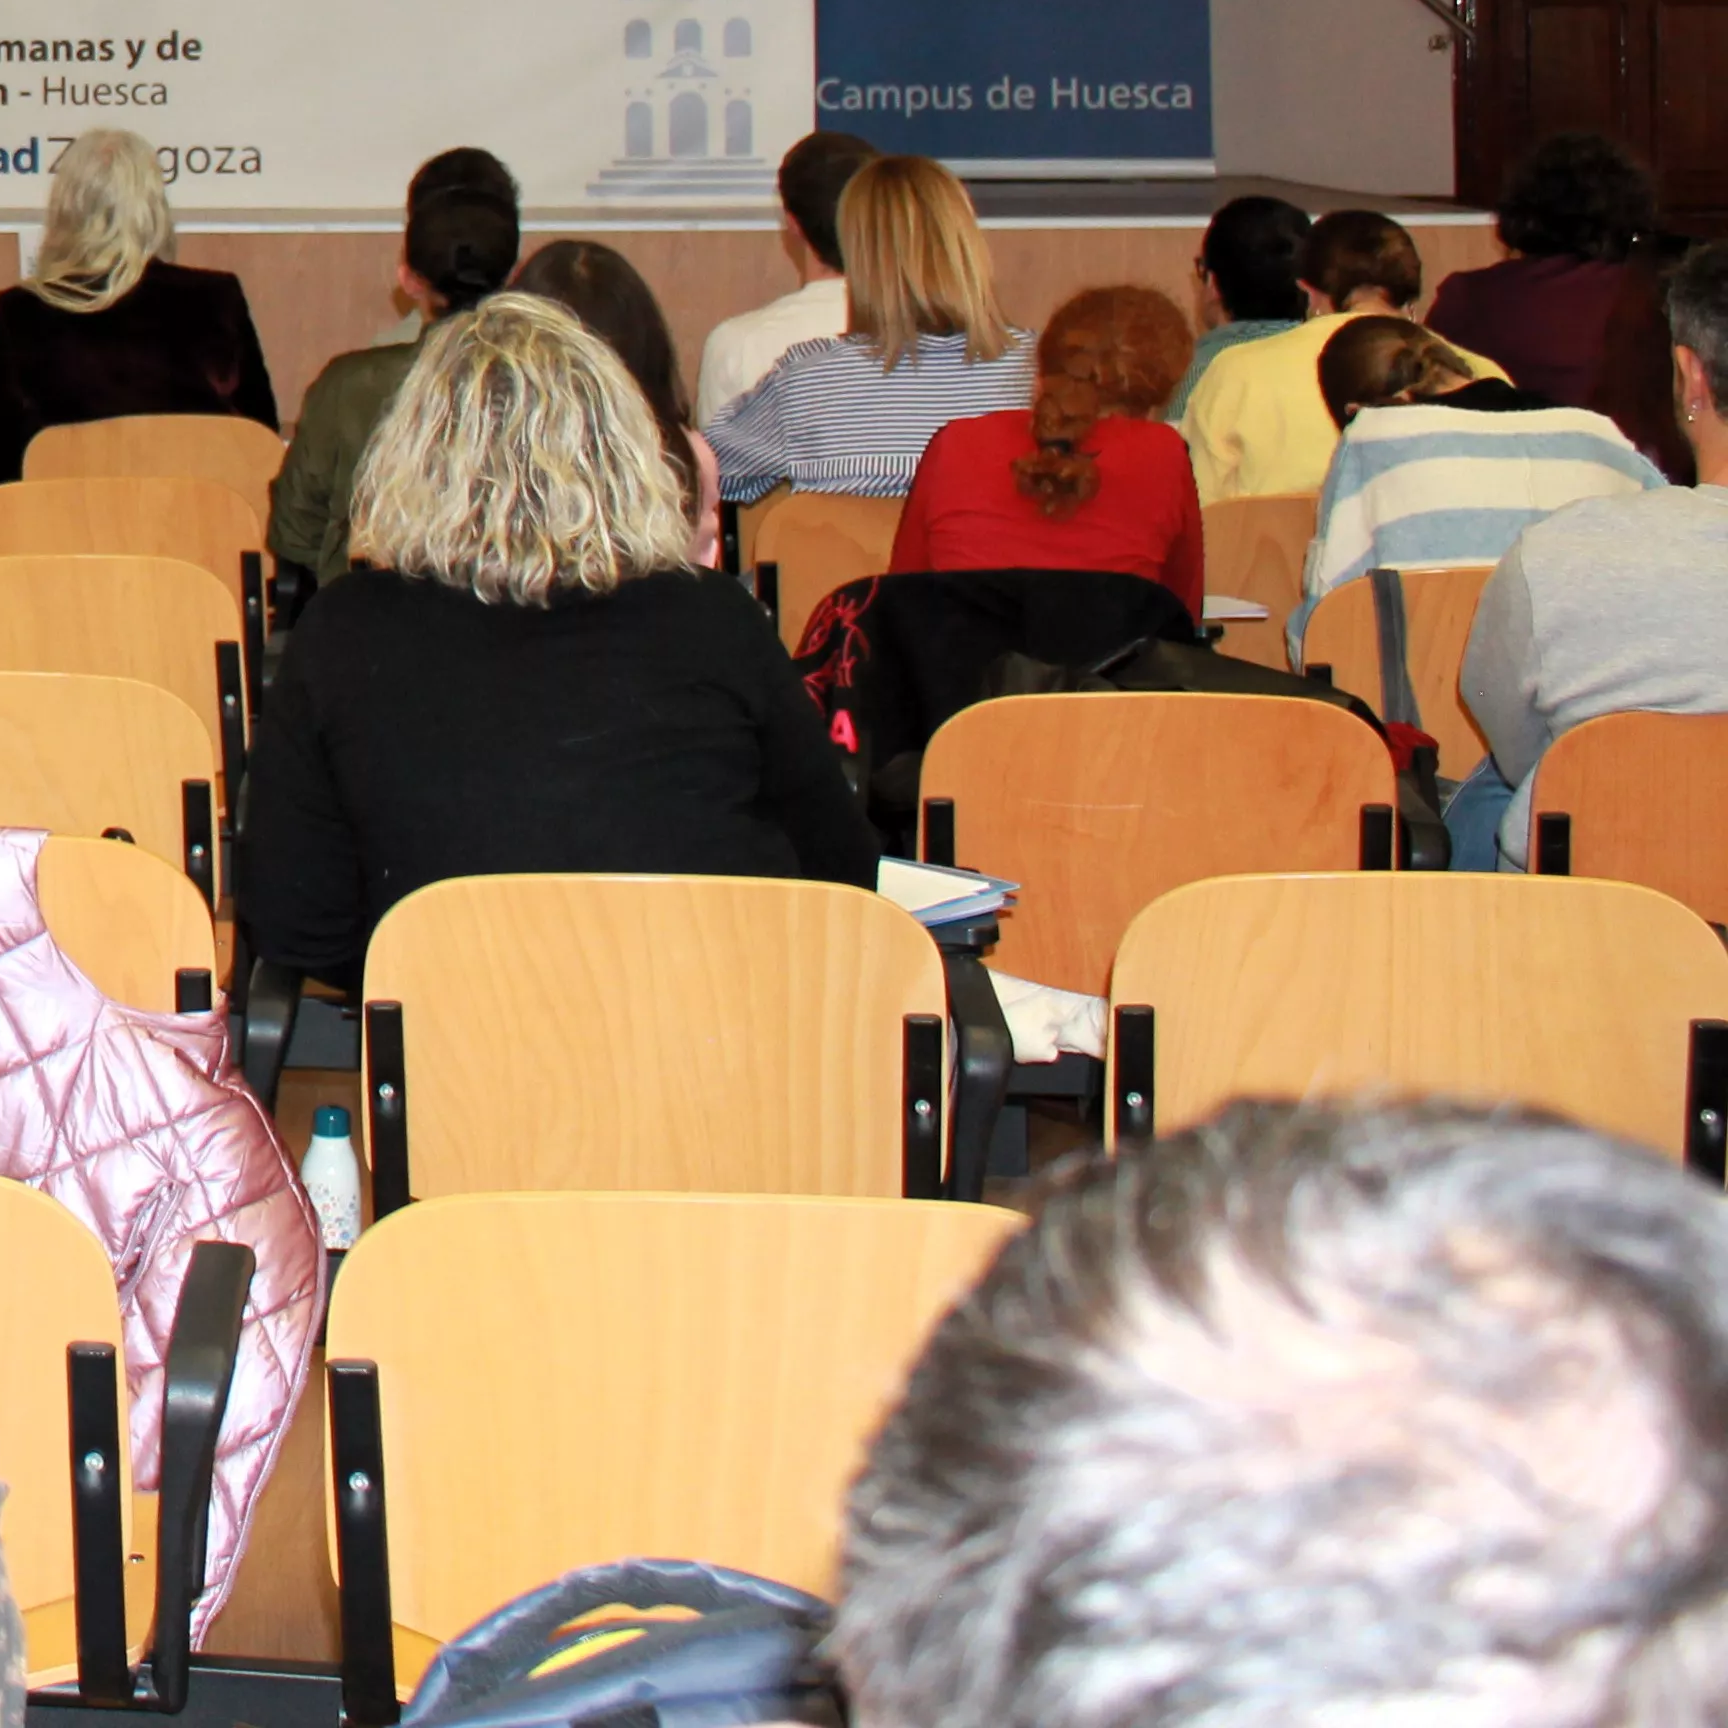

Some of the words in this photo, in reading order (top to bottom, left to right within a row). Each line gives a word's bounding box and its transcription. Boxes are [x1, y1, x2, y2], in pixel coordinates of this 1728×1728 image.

[126, 37, 146, 69] y
[156, 30, 202, 61] de
[43, 76, 169, 107] Huesca
[815, 76, 973, 117] Campus
[986, 75, 1036, 109] de
[1050, 75, 1193, 109] Huesca
